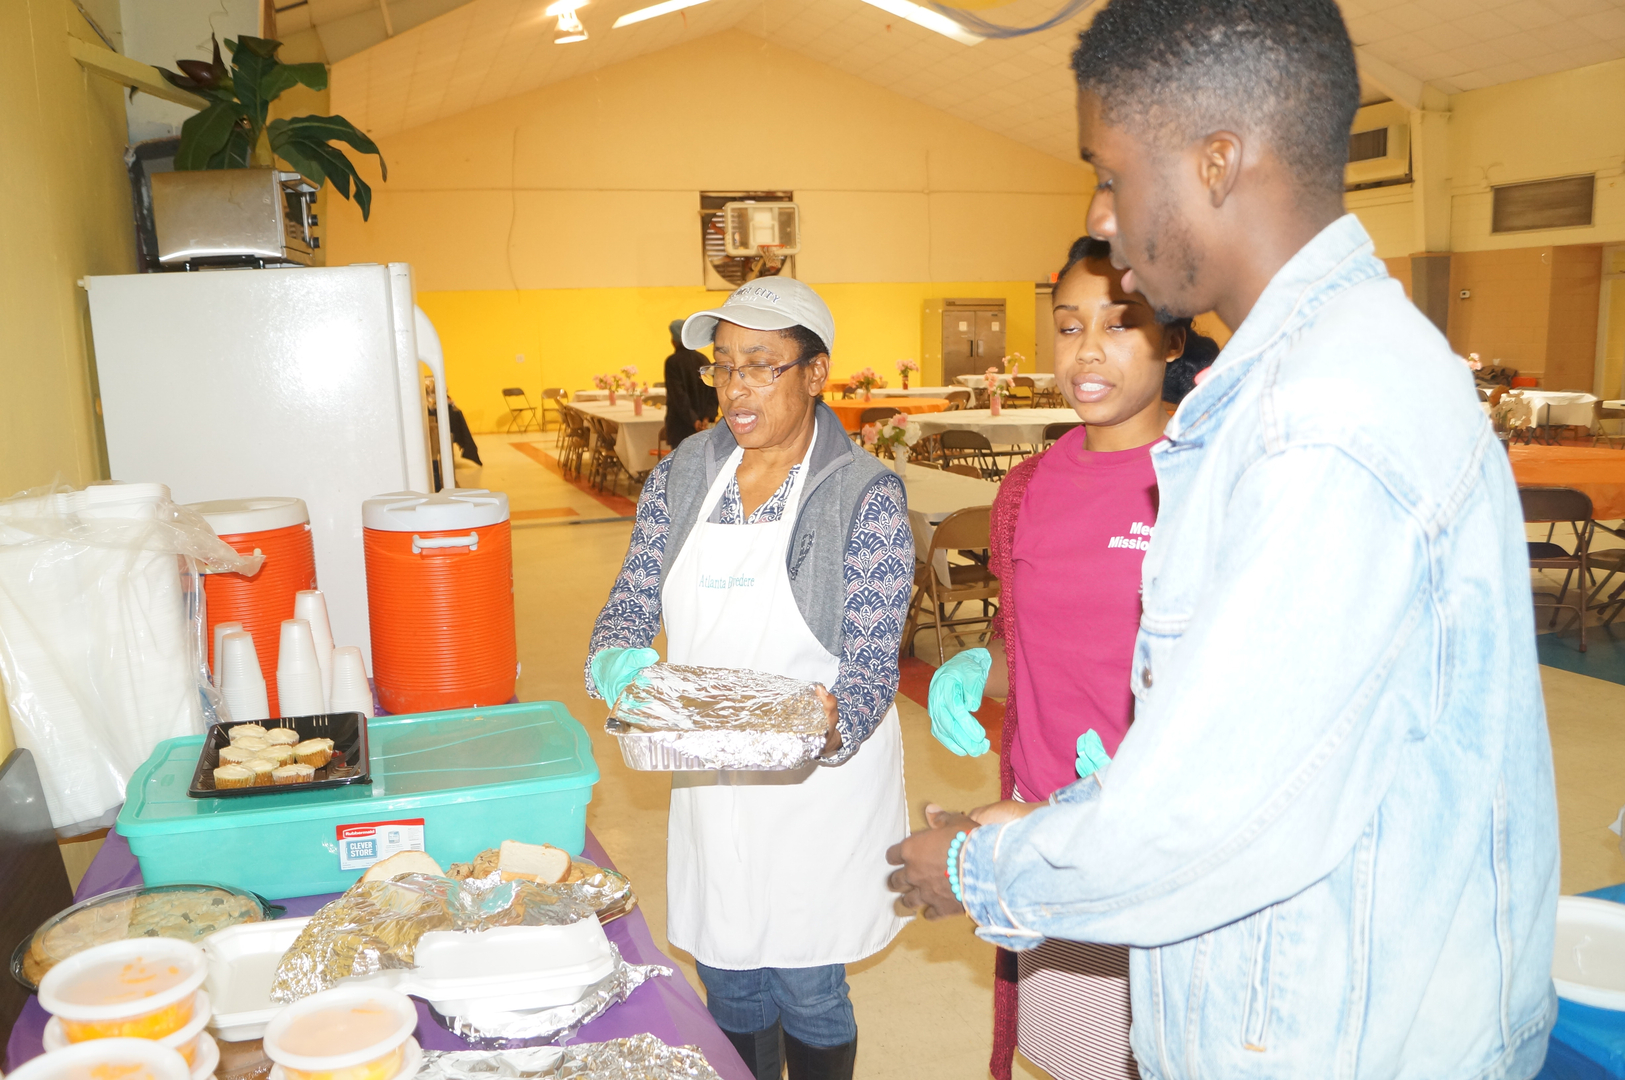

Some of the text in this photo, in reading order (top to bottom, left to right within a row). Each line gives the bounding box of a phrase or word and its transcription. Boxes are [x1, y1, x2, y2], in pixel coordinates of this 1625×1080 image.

[754, 287, 781, 304] CITY
[1107, 536, 1150, 551] Missio
[699, 574, 726, 589] Atlanta
[345, 829, 375, 837] Rubbermaid
[349, 841, 373, 850] CLEVER
[350, 848, 374, 858] STORE
